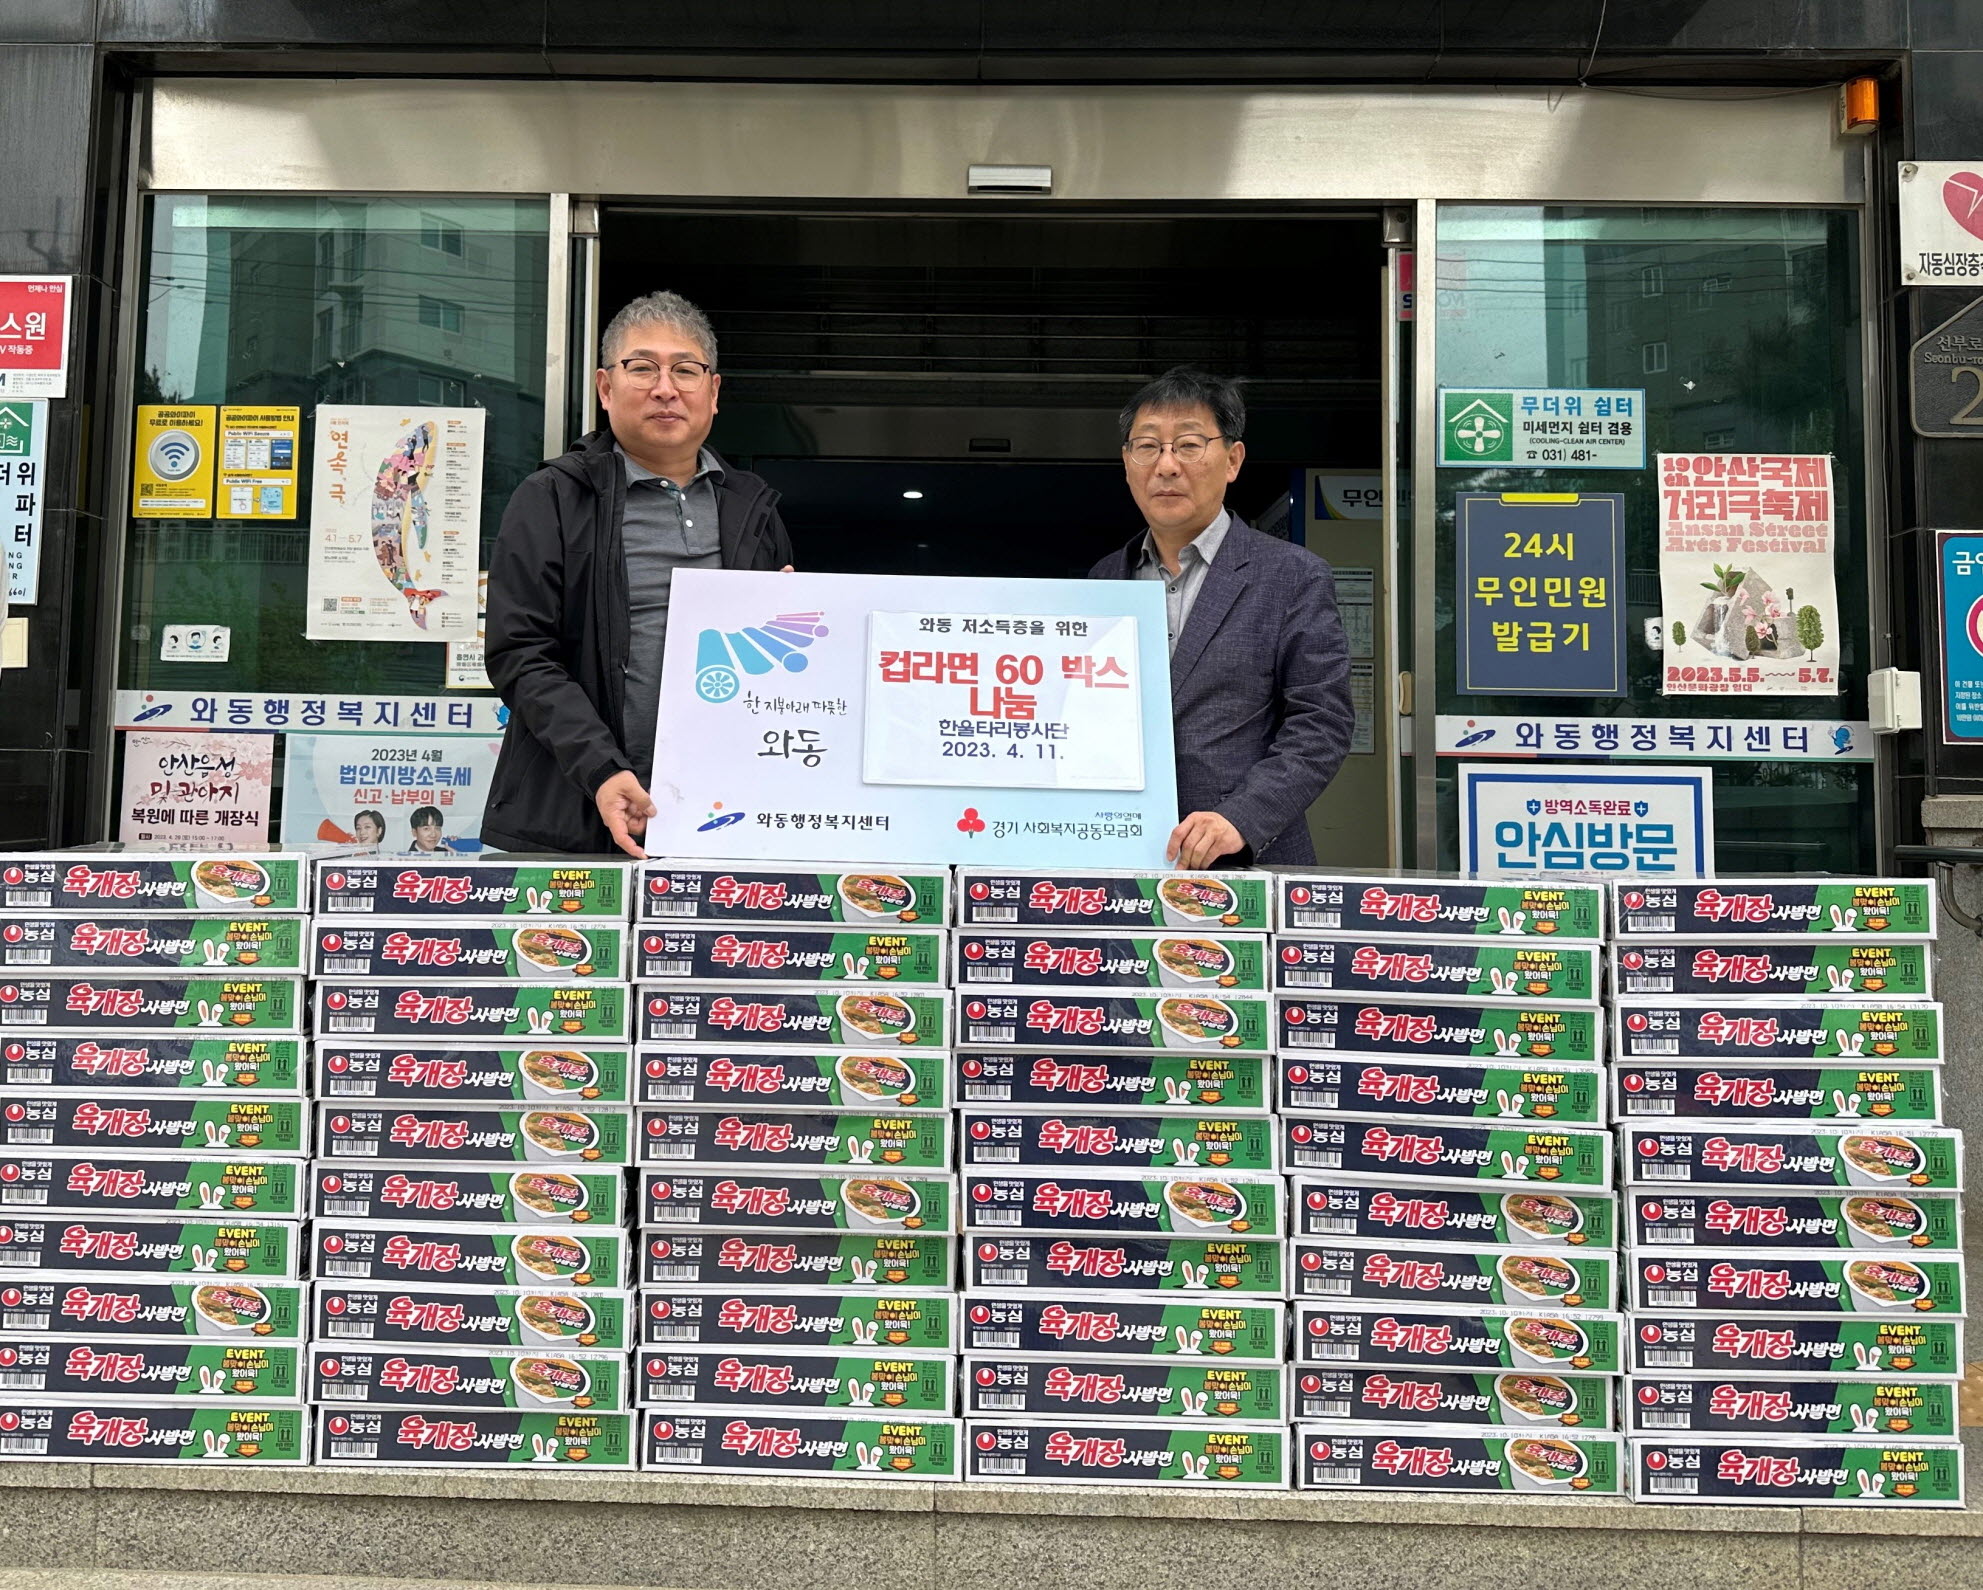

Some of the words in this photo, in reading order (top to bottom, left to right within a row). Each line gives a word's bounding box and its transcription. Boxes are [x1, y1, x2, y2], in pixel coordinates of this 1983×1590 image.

[8, 344, 34, 355] 작동중
[1520, 396, 1582, 417] 무더위
[1594, 396, 1632, 417] 쉼터
[1522, 421, 1573, 435] 미세먼지
[1578, 421, 1602, 435] 쉼터
[1607, 422, 1632, 436] 겸용
[1585, 438, 1597, 446] AIR
[1598, 438, 1626, 446] CENTER)
[1542, 450, 1567, 462] 031)
[1692, 456, 1828, 488] 안산국제
[1663, 488, 1829, 522] 거리극축제
[1665, 521, 1744, 537] Ansan
[1749, 521, 1829, 538] Street
[1503, 532, 1574, 561] 24시
[1665, 537, 1721, 553] Arts
[1726, 537, 1827, 553] Festival
[1474, 576, 1607, 608] 무인민원
[919, 618, 952, 633] 와동
[962, 619, 1046, 636] 저소득층을
[1055, 620, 1088, 637] 위한
[1492, 621, 1590, 653] 발급기
[878, 650, 979, 685] 컵라면
[995, 654, 1044, 686] 60
[1061, 655, 1130, 689] 박스
[743, 690, 761, 714] 한
[970, 686, 1037, 720] 나눔
[190, 697, 474, 728] 와동행정복지센터
[938, 719, 1070, 740] 한울타리봉사단
[1515, 722, 1809, 753] 와동행정복지센터
[371, 749, 417, 762] 2023년
[421, 750, 443, 763] 4월
[757, 729, 829, 768] 와동
[942, 741, 997, 758] 2023.
[1006, 744, 1024, 759] 4.
[1036, 744, 1065, 760] 11.
[339, 765, 472, 787] 법인지방소득세
[439, 789, 456, 806] 달
[1544, 799, 1632, 815] 방역소독완료
[131, 808, 175, 825] 복원에
[180, 809, 210, 825] 따른
[214, 810, 259, 827] 개장식
[756, 812, 890, 832] 와동행정복지센터
[992, 821, 1019, 839] 경기
[1023, 822, 1143, 841] 사회복지공동모금회
[1495, 821, 1677, 872] 안심방문
[25, 870, 55, 883] 농심
[63, 866, 140, 898] 육개장
[137, 880, 188, 896] 사발면
[346, 875, 377, 888] 농심
[553, 871, 593, 882] EVENT
[392, 870, 472, 904] 육개장
[469, 884, 519, 904] 사발면
[670, 880, 701, 893] 농심
[709, 876, 787, 910] 육개장
[784, 890, 834, 906] 사발면
[989, 886, 1020, 898] 농심
[1855, 887, 1896, 898] EVENT
[1028, 881, 1107, 915] 육개장
[1104, 896, 1154, 910] 사발면
[1311, 890, 1343, 904] 농심
[1359, 887, 1441, 922] 육개장
[1438, 901, 1490, 921] 사발면
[1525, 892, 1566, 903] EVENT
[1646, 895, 1677, 907] 농심
[1693, 889, 1773, 922] 육개장
[1770, 903, 1822, 920] 사발면
[350, 1118, 381, 1132] 농심
[389, 1114, 469, 1149] 육개장
[466, 1128, 519, 1147] 사발면
[991, 1124, 1022, 1138] 농심
[1199, 1122, 1239, 1133] EVENT
[1037, 1119, 1117, 1155] 육개장
[1114, 1133, 1165, 1153] 사발면
[20, 1415, 52, 1429] 농심
[230, 1413, 270, 1424] EVENT
[67, 1411, 148, 1446] 육개장
[145, 1425, 196, 1445] 사발면
[674, 1424, 705, 1438] 농심
[884, 1426, 924, 1437] EVENT
[721, 1421, 801, 1457] 육개장
[798, 1435, 848, 1457] 사발면
[1331, 1445, 1363, 1459] 농심
[1372, 1440, 1453, 1477] 육개장
[1450, 1454, 1503, 1473] 사발면
